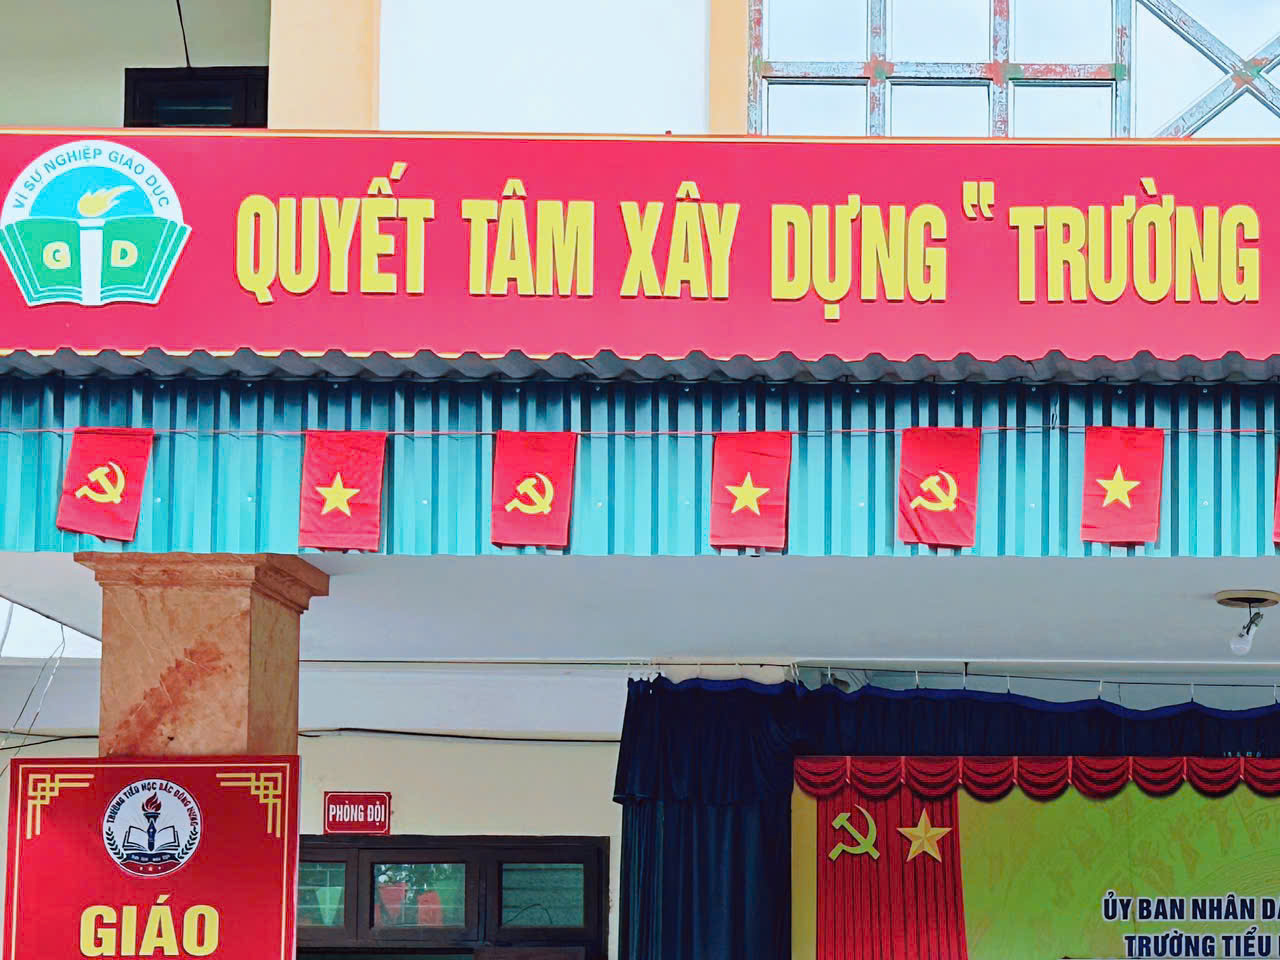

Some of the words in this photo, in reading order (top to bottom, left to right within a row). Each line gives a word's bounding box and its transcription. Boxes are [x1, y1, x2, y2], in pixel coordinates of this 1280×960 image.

[111, 240, 138, 268] D
[236, 161, 434, 304] QUYẾT
[461, 179, 595, 297] TÂM
[619, 181, 741, 299] XÂY
[771, 194, 948, 320] DỰNG
[329, 800, 365, 822] PHÒNG
[367, 800, 385, 826] ĐỘI
[1103, 891, 1133, 920] ỦY
[1138, 898, 1185, 920] BAN
[1191, 893, 1255, 920] NHÂN
[79, 894, 219, 957] GIÁO
[1124, 930, 1216, 957] TRƯỜNG
[1221, 926, 1271, 957] TIỂU
